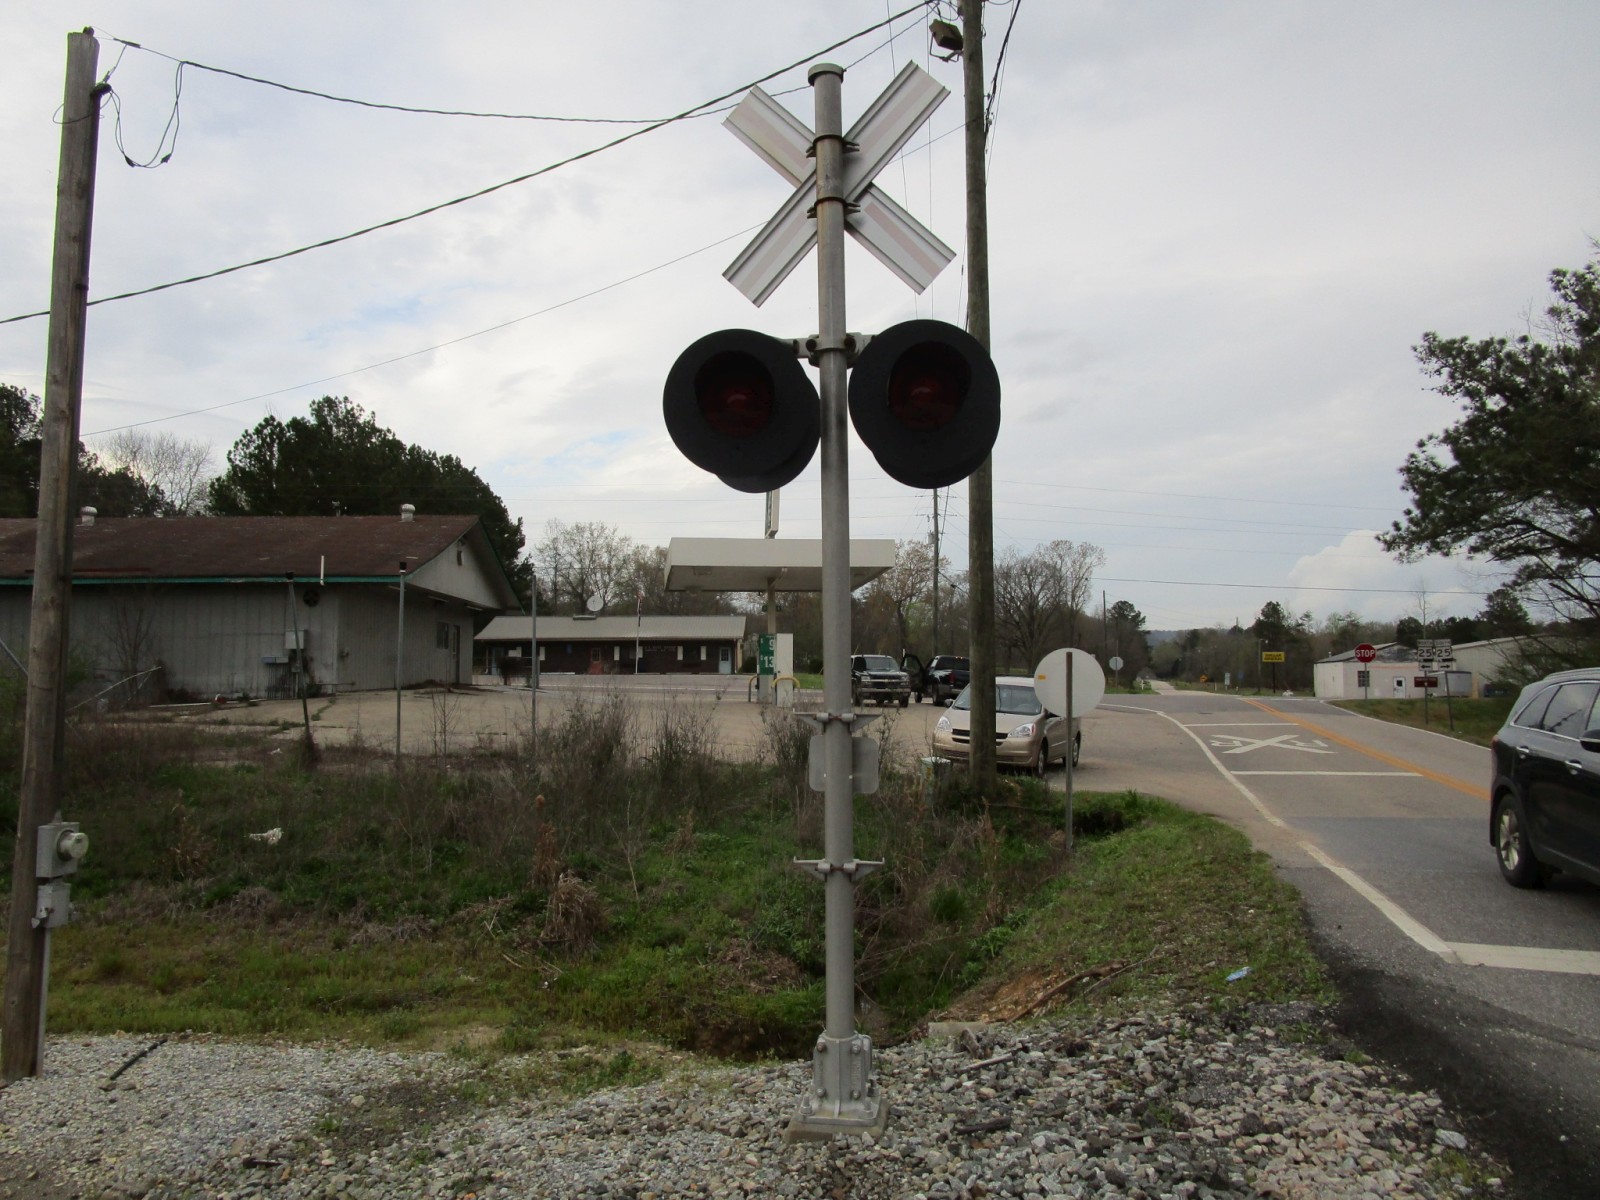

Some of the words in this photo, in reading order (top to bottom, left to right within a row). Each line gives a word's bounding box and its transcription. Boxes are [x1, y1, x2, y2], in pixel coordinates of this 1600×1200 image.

[1355, 649, 1376, 657] STOP
[1418, 649, 1432, 657] 25
[1437, 648, 1451, 657] 25
